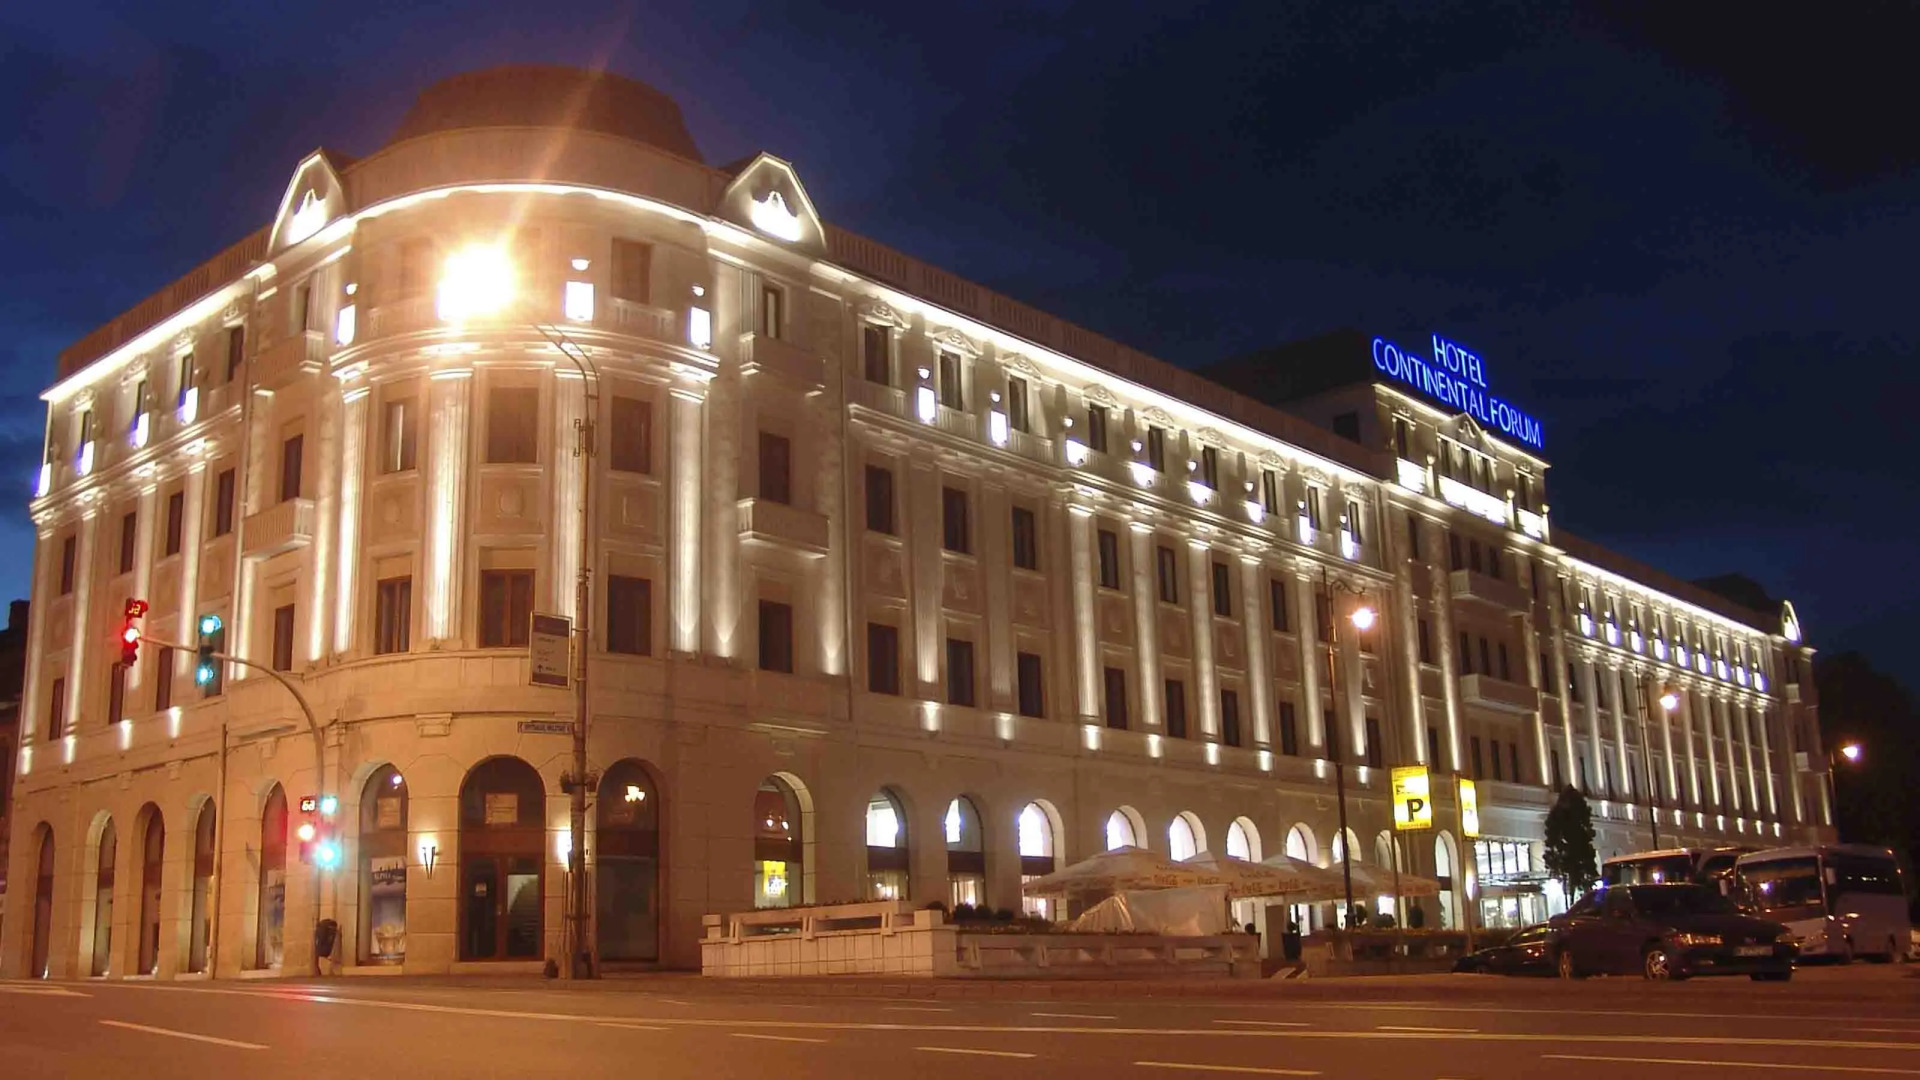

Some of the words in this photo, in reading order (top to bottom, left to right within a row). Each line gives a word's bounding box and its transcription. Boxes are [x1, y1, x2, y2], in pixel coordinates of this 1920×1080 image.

[1432, 334, 1487, 388] HOTEL
[1372, 338, 1489, 422] CONTINENTAL
[1490, 397, 1542, 448] FORUM
[1406, 798, 1424, 822] P
